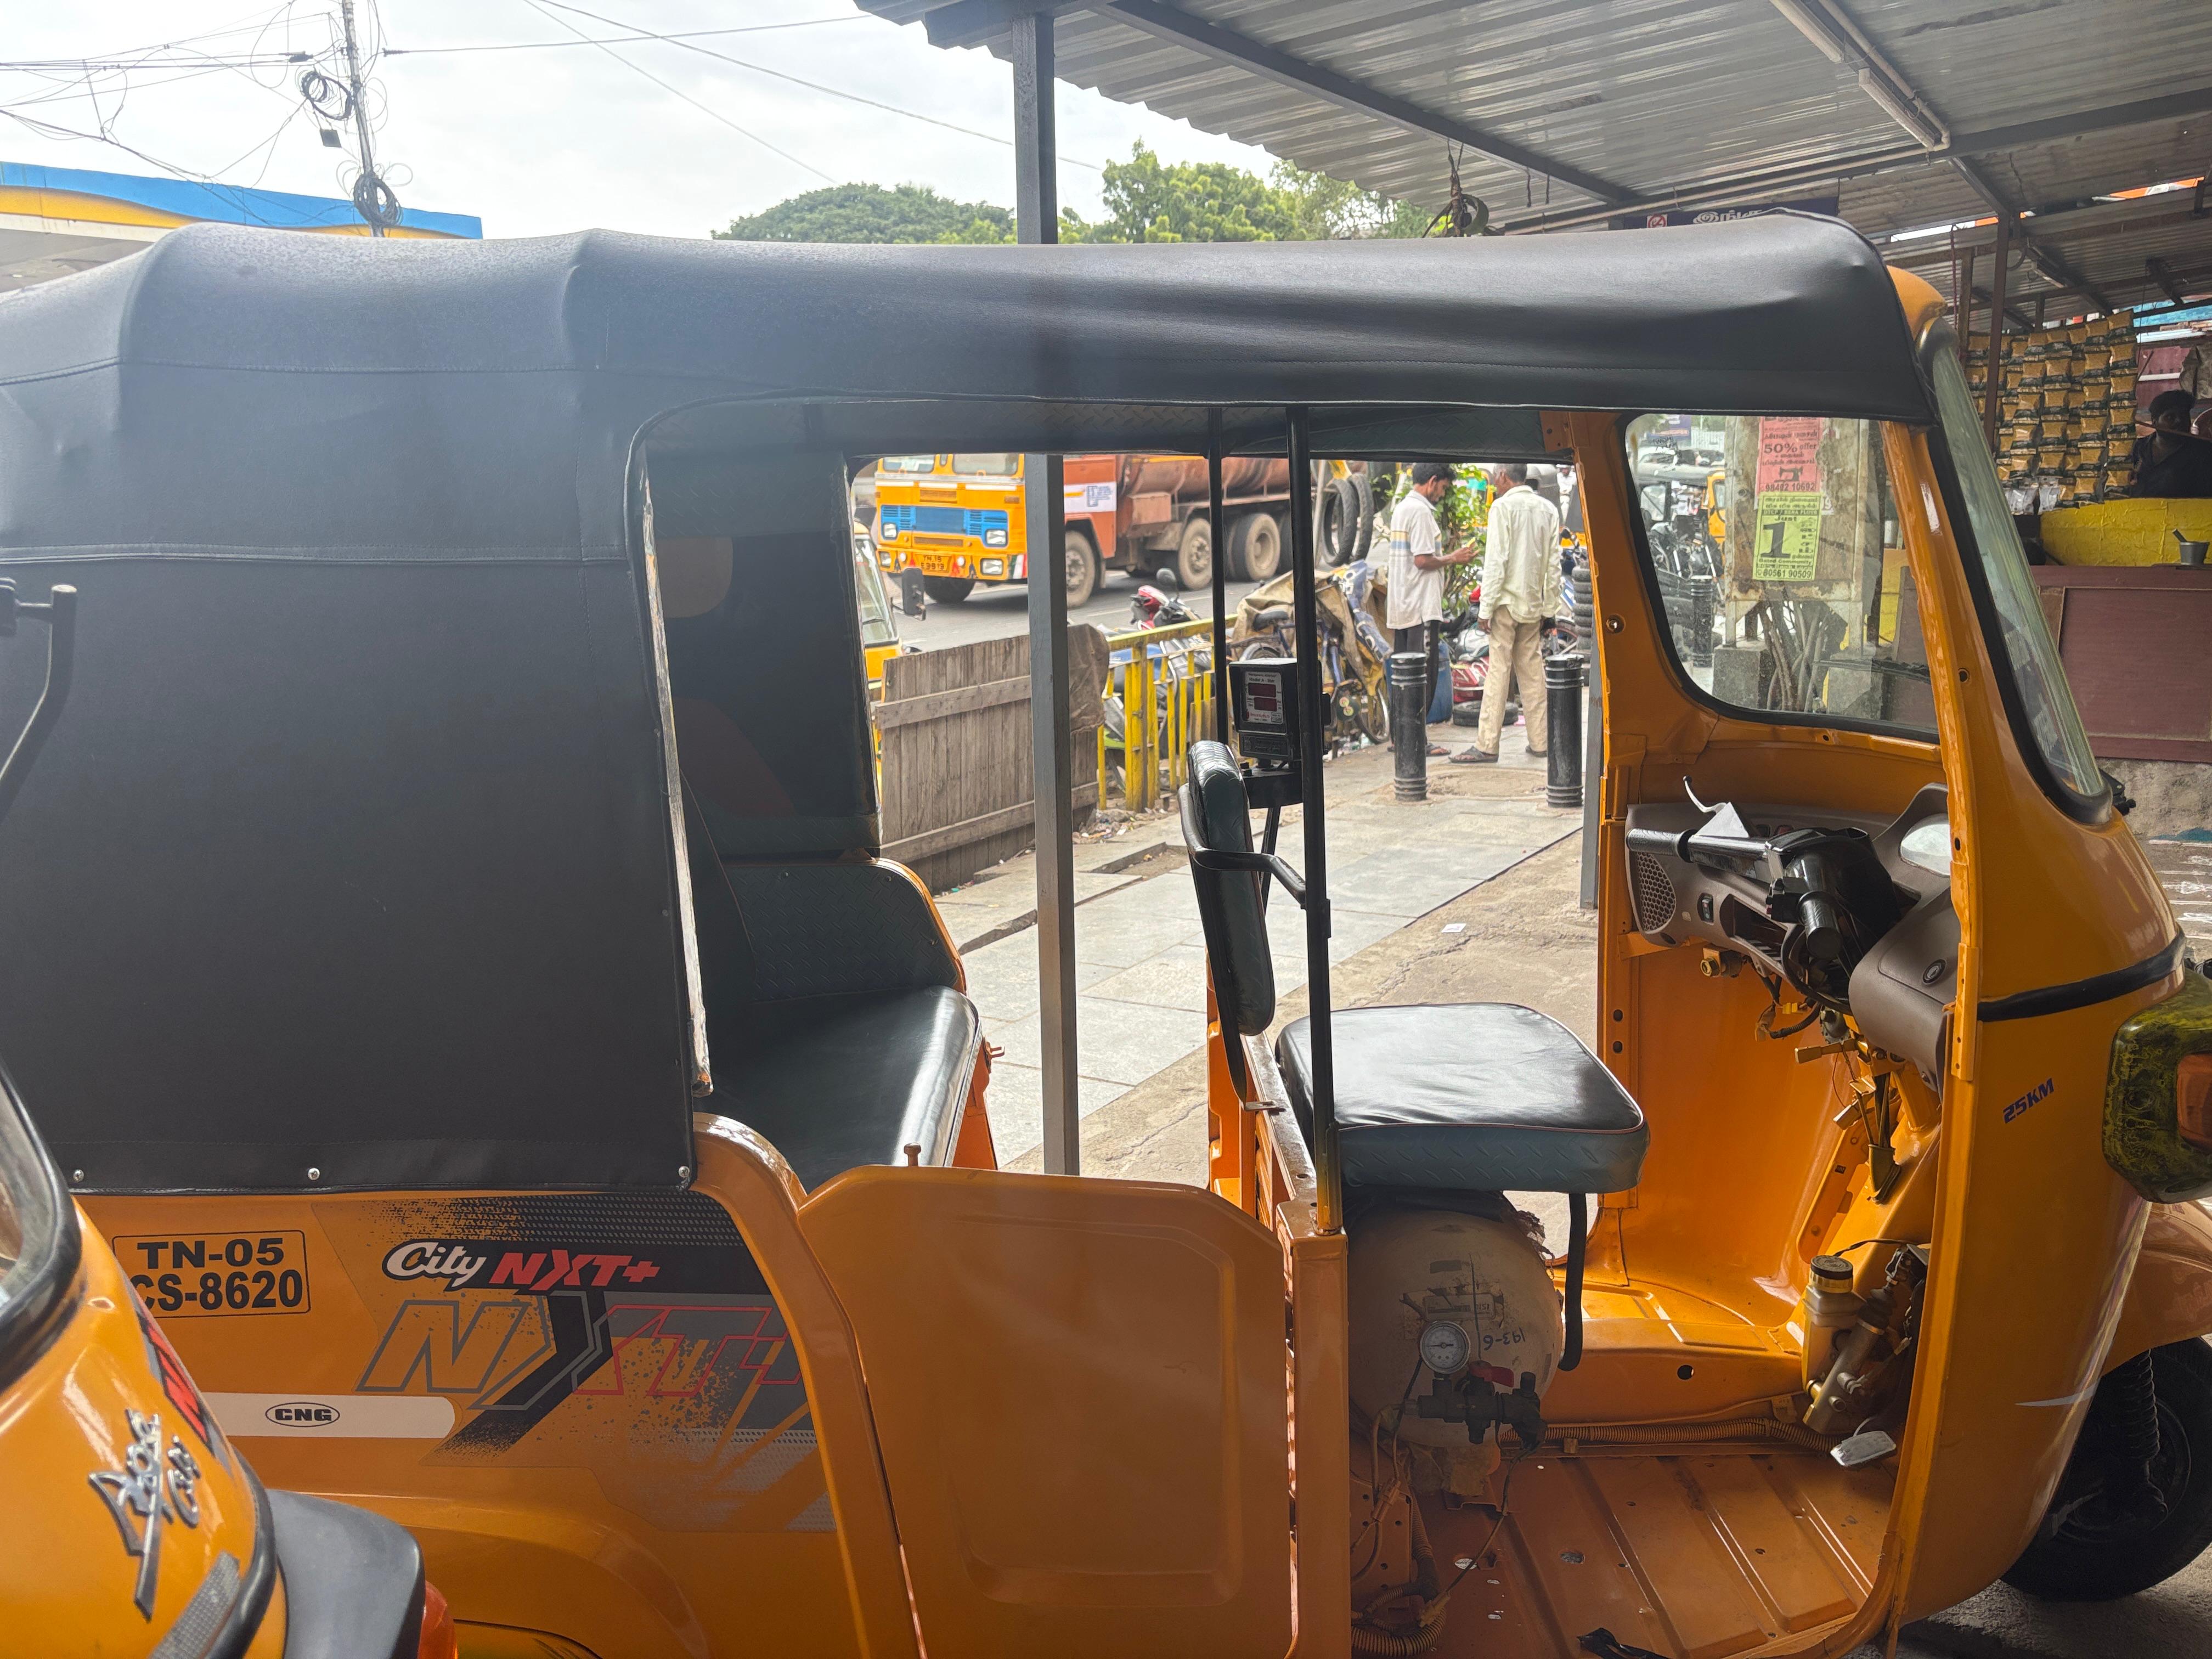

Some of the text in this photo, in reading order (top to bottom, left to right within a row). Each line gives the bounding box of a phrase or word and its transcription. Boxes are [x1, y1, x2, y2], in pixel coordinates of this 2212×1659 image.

[1764, 443, 1798, 453] 50%
[1760, 522, 1791, 558] 1
[2002, 1077, 2055, 1124] 25KM
[137, 1238, 284, 1269] TN-05
[386, 1241, 661, 1290] City NXT+
[132, 1269, 303, 1312] CS-8620
[274, 1408, 333, 1422] CNG
